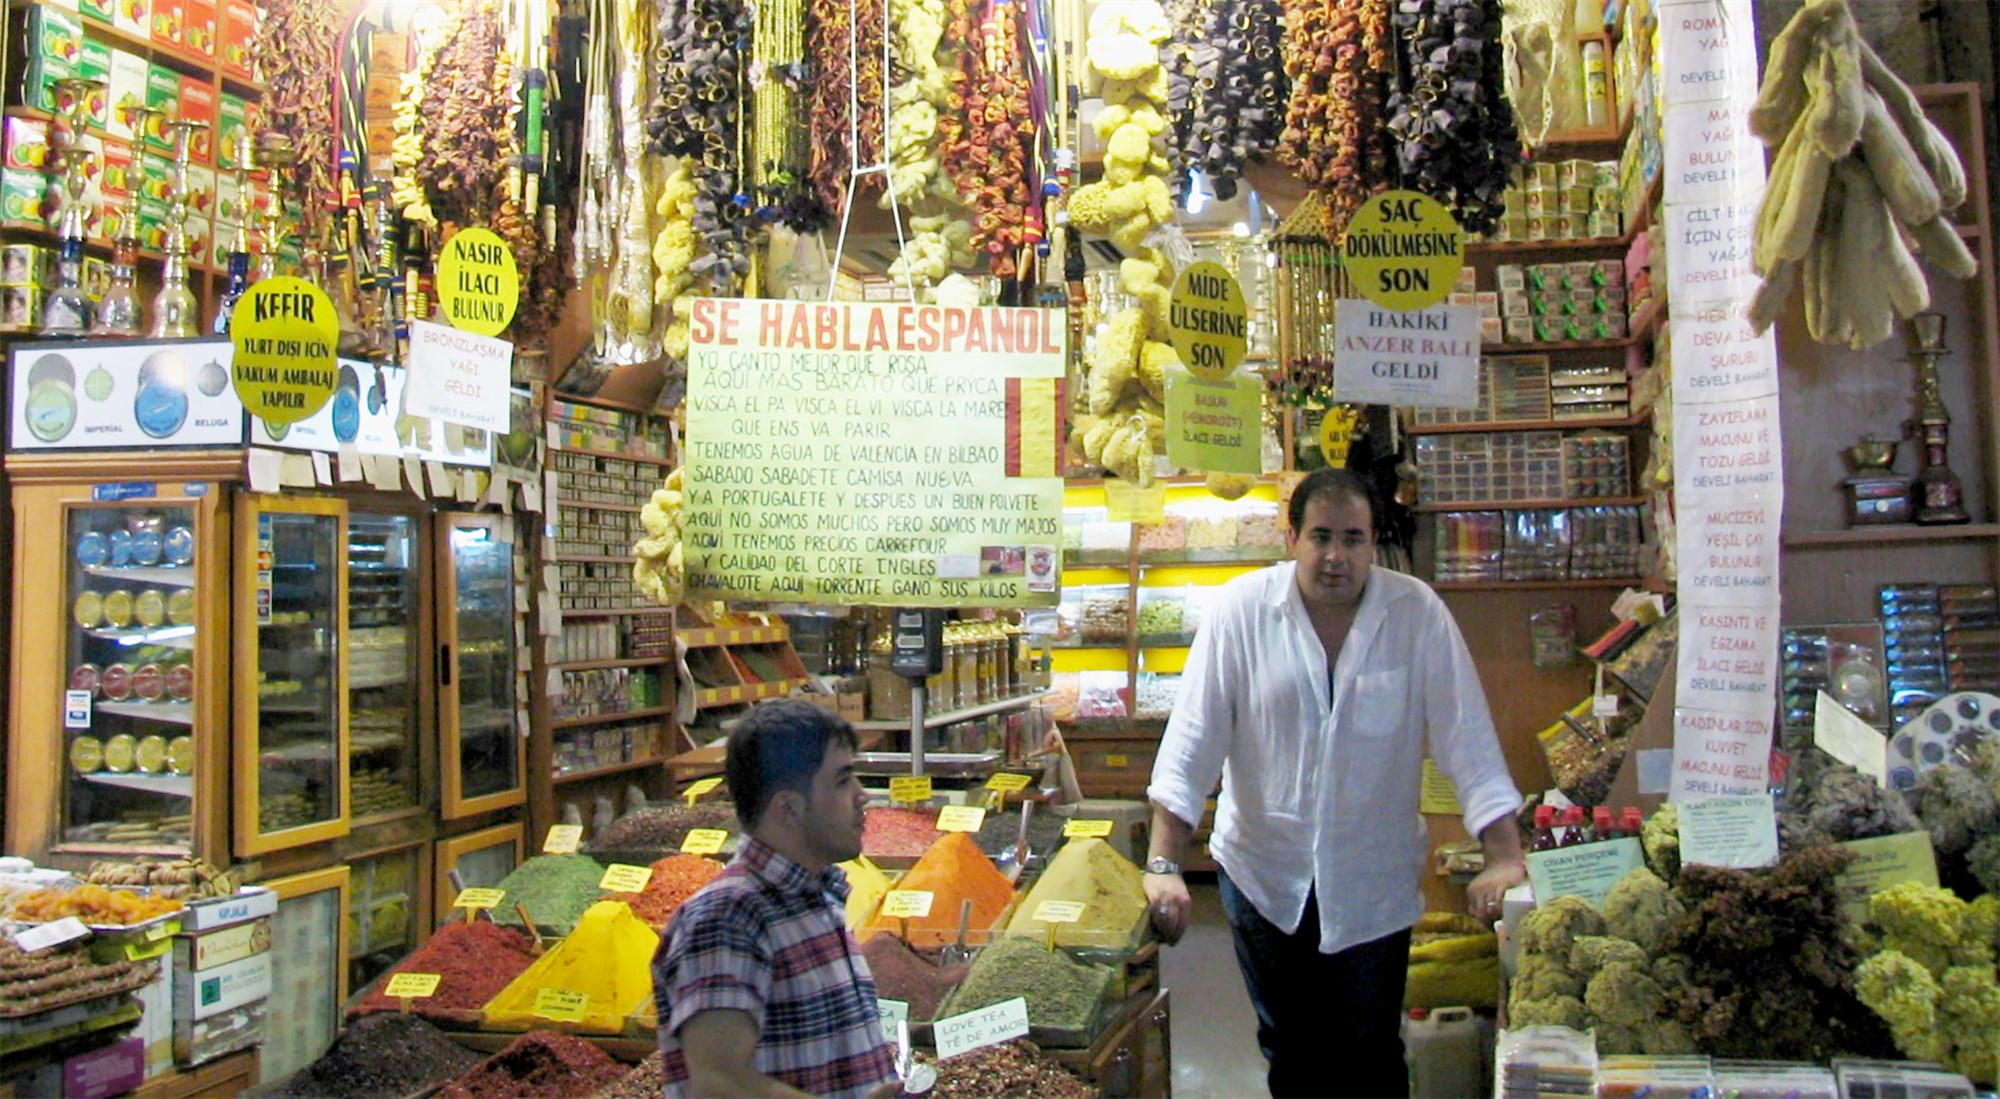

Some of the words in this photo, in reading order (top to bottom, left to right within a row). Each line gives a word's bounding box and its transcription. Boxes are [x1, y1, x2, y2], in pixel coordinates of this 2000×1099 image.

[1379, 198, 1423, 228] SAÇ
[455, 239, 503, 267] NASIR
[1349, 227, 1458, 258] DÖKÜLMESİNE
[459, 265, 500, 296] İLACI
[1188, 269, 1229, 301] MİDE
[1379, 268, 1430, 293] SON
[453, 297, 505, 324] BULUNUR
[1170, 298, 1245, 339] ÜLSERİNE
[1369, 311, 1449, 331] HAKİKİ
[691, 300, 740, 346] SE
[759, 302, 890, 351] HABLA
[897, 306, 1061, 355] ESPANOL
[1693, 331, 1733, 347] DEVA
[244, 337, 273, 355] YURT
[277, 338, 301, 361] DIŞI
[423, 330, 505, 360] BRONZLAŞMA
[1191, 342, 1225, 370] SON
[1342, 336, 1414, 354] ANZER
[1422, 340, 1471, 356] BALI
[698, 351, 719, 371] YO
[729, 352, 780, 373] CANTO
[790, 353, 840, 373] MEJOR
[847, 355, 874, 375] QUE
[888, 355, 928, 375] ROSA
[1372, 361, 1439, 380] GELDİ
[236, 365, 278, 383] VAKUM
[281, 368, 334, 390] AMBALAJ
[758, 372, 803, 392] MAS
[816, 373, 894, 393] BARATO
[902, 375, 938, 395] QUE
[945, 376, 999, 395] PRYCA
[262, 390, 306, 409] YAPILIR
[694, 396, 737, 413] VISCA
[744, 397, 761, 414] EL
[767, 397, 785, 414] PA
[795, 398, 838, 416] VISCA
[846, 400, 862, 416] EL
[869, 400, 882, 416] VI
[892, 400, 934, 417] VISCA
[939, 401, 957, 418] LA
[963, 400, 1006, 419] MARE
[731, 419, 761, 437] QUE
[769, 419, 800, 437] ENS
[810, 421, 830, 438] VA
[844, 421, 892, 439] PARIR
[1699, 409, 1768, 426] ZAYIFLAMA
[1757, 428, 1769, 443] VE
[694, 441, 762, 459] TENEMOS
[770, 442, 813, 460] AGUA
[824, 444, 841, 462] DE
[924, 446, 942, 464] EN
[1698, 455, 1735, 469] TOZU
[692, 465, 753, 484] SABADO
[760, 466, 838, 486] SABADETE
[915, 469, 974, 488] NUEVA
[687, 488, 698, 505] Y
[701, 489, 713, 506] A
[722, 489, 826, 508] PORTUGALETE
[835, 491, 846, 508] Y
[854, 491, 917, 509] DESPUES
[924, 491, 944, 510] UN
[952, 492, 984, 511] BUEN
[989, 493, 1038, 512] POLVETE
[730, 514, 751, 529] NO
[758, 513, 809, 531] SOMOS
[817, 514, 879, 532] MUCHOS
[887, 514, 923, 533] PERO
[929, 515, 976, 534] SOMOS
[981, 516, 1012, 535] MUY
[1015, 517, 1057, 536] MAJOS
[732, 533, 796, 551] TENEMOS
[865, 535, 947, 555] CARREFOUR
[701, 555, 711, 571] Y
[785, 557, 809, 574] DEL
[817, 557, 863, 575] CORTE
[878, 557, 936, 576] INGLES
[1709, 555, 1762, 569] BULUNUR
[815, 578, 881, 596] TORRENTE
[892, 578, 931, 597] GANO
[939, 580, 969, 598] SUS
[1705, 740, 1747, 755] KUVVET
[943, 1019, 976, 1035] LOVE
[983, 1009, 1007, 1023] TEA
[968, 1031, 983, 1043] DE
[990, 1018, 1026, 1036] AMOR
